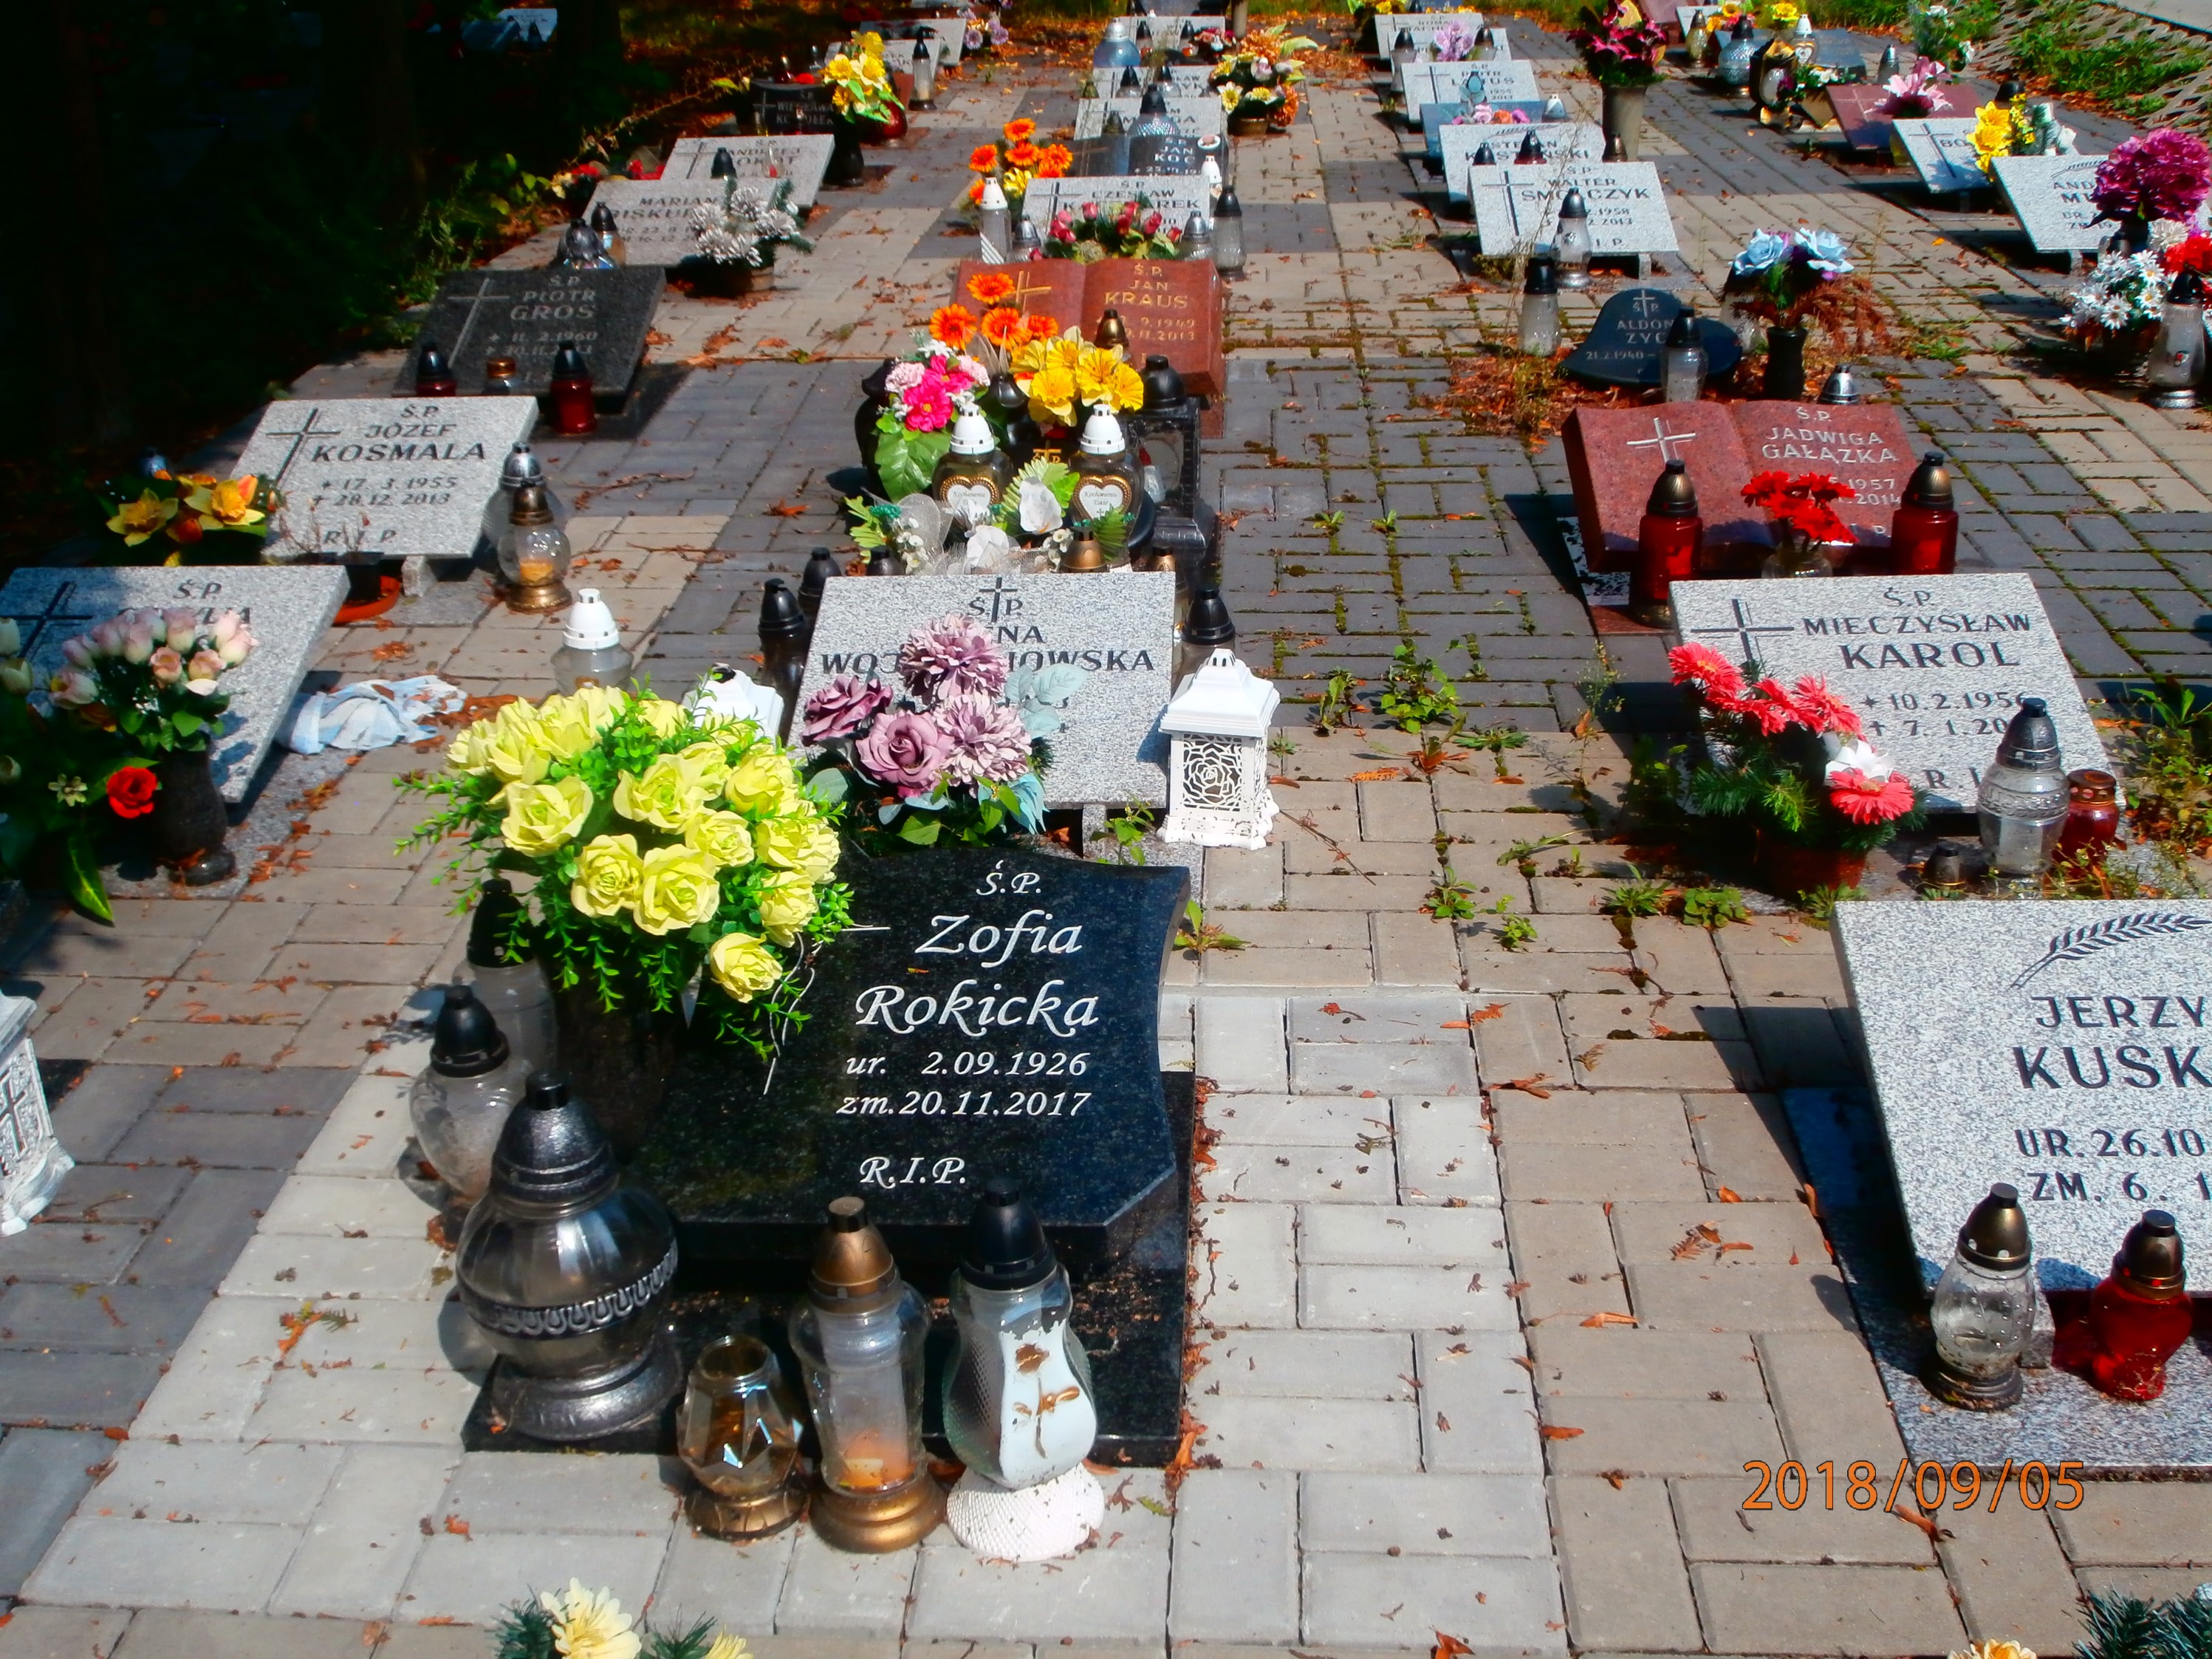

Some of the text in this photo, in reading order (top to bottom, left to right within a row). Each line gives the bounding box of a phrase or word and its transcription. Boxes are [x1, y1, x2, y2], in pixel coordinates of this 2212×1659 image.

[1154, 153, 1195, 164] KOC
[1159, 146, 1194, 154] JAN
[1548, 178, 1616, 187] WALTER
[1521, 188, 1650, 201] SMOCZYK
[1129, 281, 1169, 291] JAN
[523, 290, 597, 303] PIOTR
[1105, 291, 1189, 309] KRAUS
[510, 304, 595, 321] GROS
[364, 422, 457, 439] JÓZEF
[1765, 426, 1884, 445] JADWIGA
[311, 442, 487, 463] KOSMALA
[1761, 443, 1900, 466] GAŁĄZKA
[173, 579, 222, 599] Ś.P.
[1883, 586, 1936, 607] Ś.P.
[1803, 613, 2032, 637] MIECZYSŁAW
[1840, 641, 2021, 669] KAROL
[976, 859, 1042, 896] Ś.P.
[914, 909, 1083, 968] Zofia
[855, 979, 1100, 1038] Rokicka
[2031, 996, 2205, 1029] JERZY
[845, 1051, 1092, 1076] ur. 2.09.1926
[859, 1156, 968, 1189] R.I.P.
